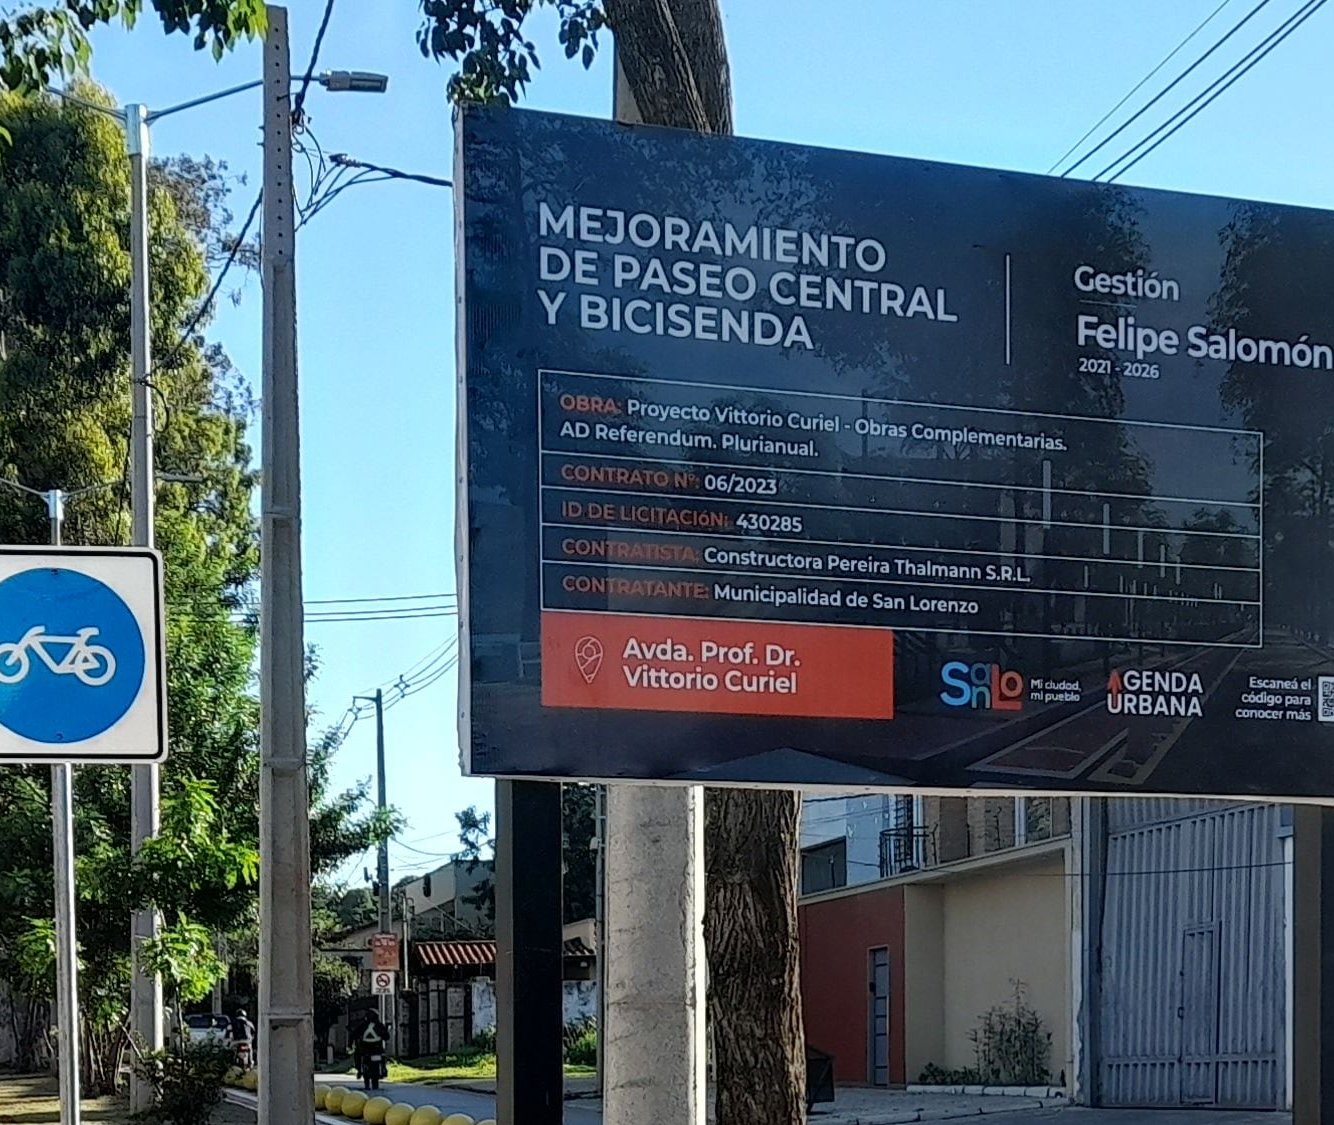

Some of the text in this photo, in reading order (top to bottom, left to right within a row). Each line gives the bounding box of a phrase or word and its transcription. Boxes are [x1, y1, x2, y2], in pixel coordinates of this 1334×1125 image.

[539, 201, 886, 272] MEJORAMIENTO
[540, 247, 958, 322] DE PASEO CENTRAL
[1074, 265, 1179, 300] Gestión
[538, 290, 813, 349] Y BICISENDA
[1077, 315, 1333, 369] Felipe Salomón
[1078, 358, 1111, 375] 2021
[1123, 362, 1159, 378] 2026
[560, 394, 622, 413] OBRA:
[627, 399, 710, 422] Proyecto
[715, 406, 783, 428] Vittorio
[788, 412, 839, 432] Curiel
[854, 419, 907, 437] Obras
[911, 424, 1067, 450] Complementarias.
[560, 422, 819, 457] AD Referendum. Plurianual.
[562, 464, 668, 487] CONTRATO
[704, 474, 777, 494] 06/2023
[562, 501, 582, 519] ID
[588, 503, 615, 520] DE
[736, 513, 802, 532] 430285
[562, 538, 1030, 583] CONTRATISTA: Constructora Pereira Thalmann S.R.L.
[562, 575, 978, 614] CONTRATANTE: Municipalidad de San Lorenzo
[623, 637, 800, 666] Avda. Prof. Dr.
[623, 665, 797, 694] Vittorio Curiel
[1030, 678, 1081, 692] Mi ciudad,
[1249, 676, 1311, 690] Escaneá el
[1030, 692, 1080, 703] mi pueblo
[1107, 693, 1203, 717] URBANA
[1241, 692, 1311, 706] código para
[1235, 709, 1311, 720] conocer más
